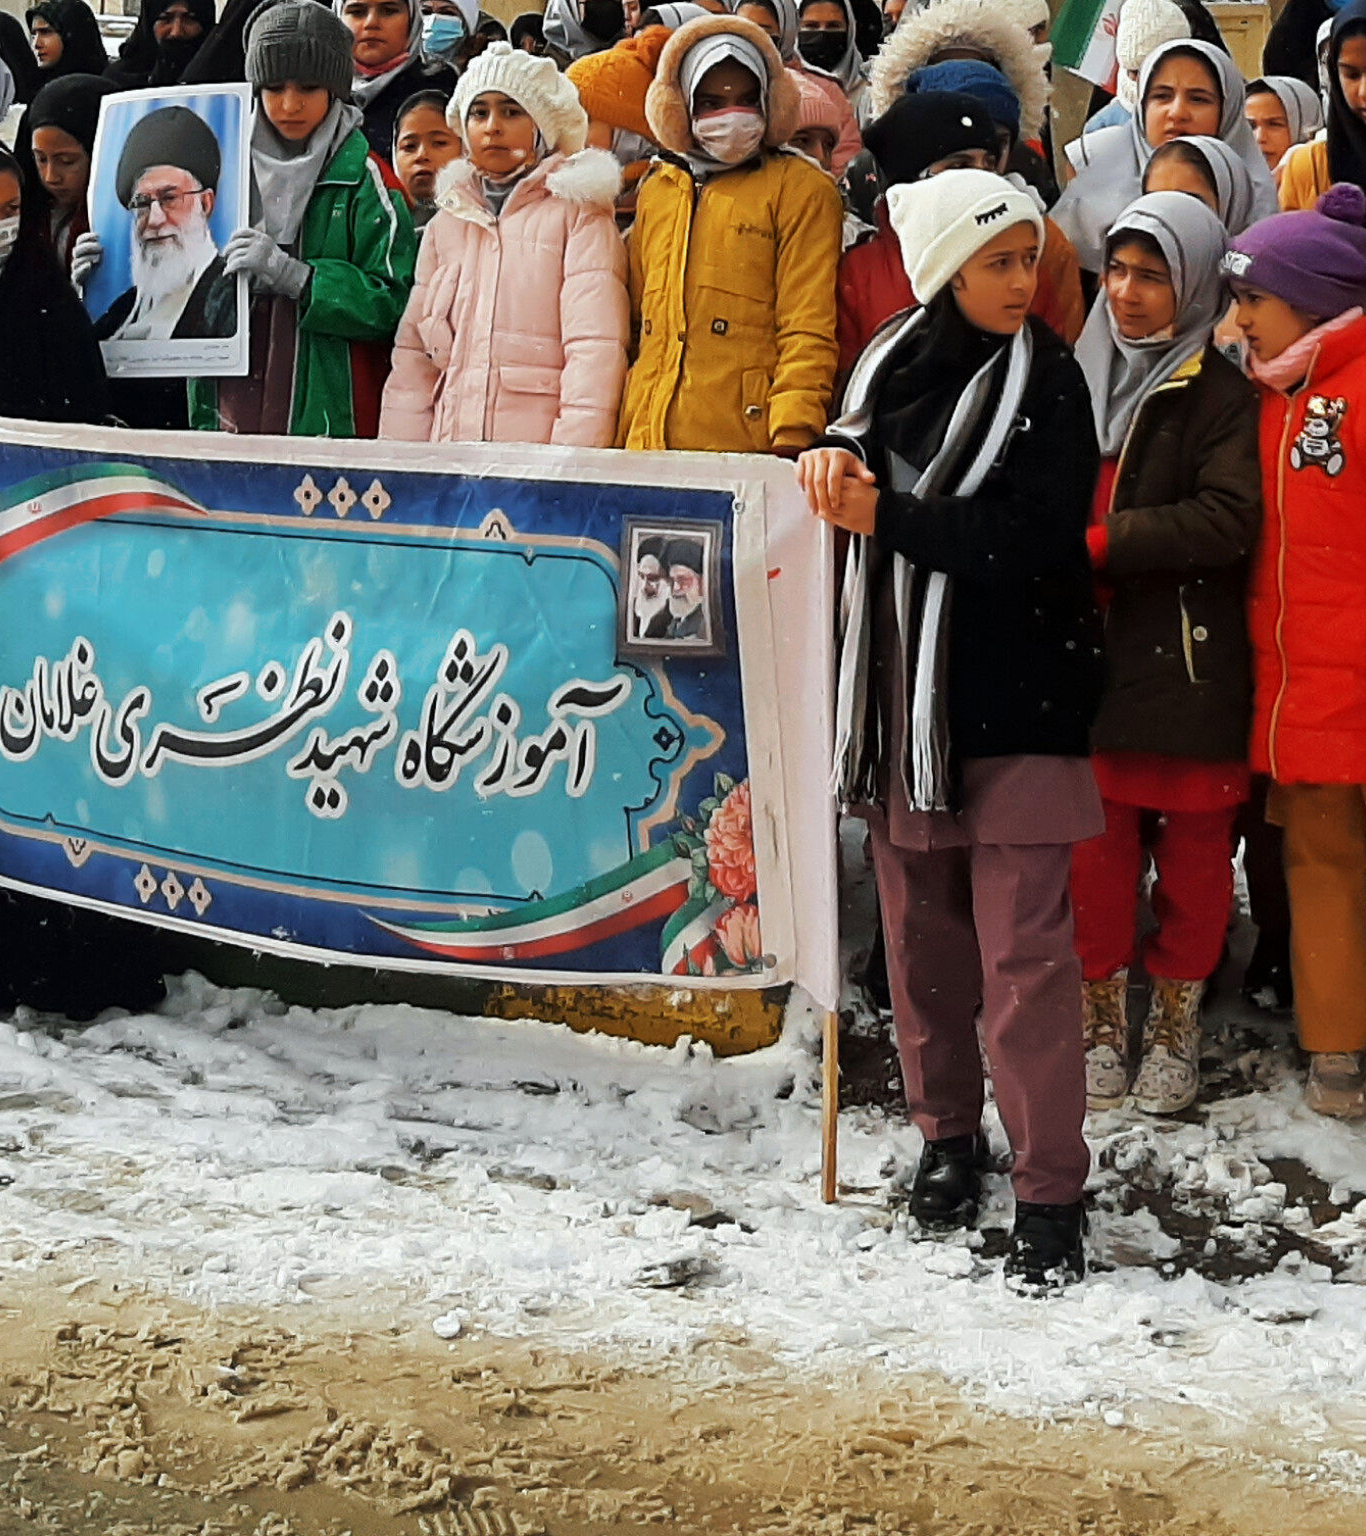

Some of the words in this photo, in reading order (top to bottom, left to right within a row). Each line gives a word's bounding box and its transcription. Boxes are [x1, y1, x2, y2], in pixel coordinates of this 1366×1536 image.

[94, 617, 346, 781] نظری
[291, 655, 397, 811] شهید
[400, 634, 624, 792] آموزشگاه
